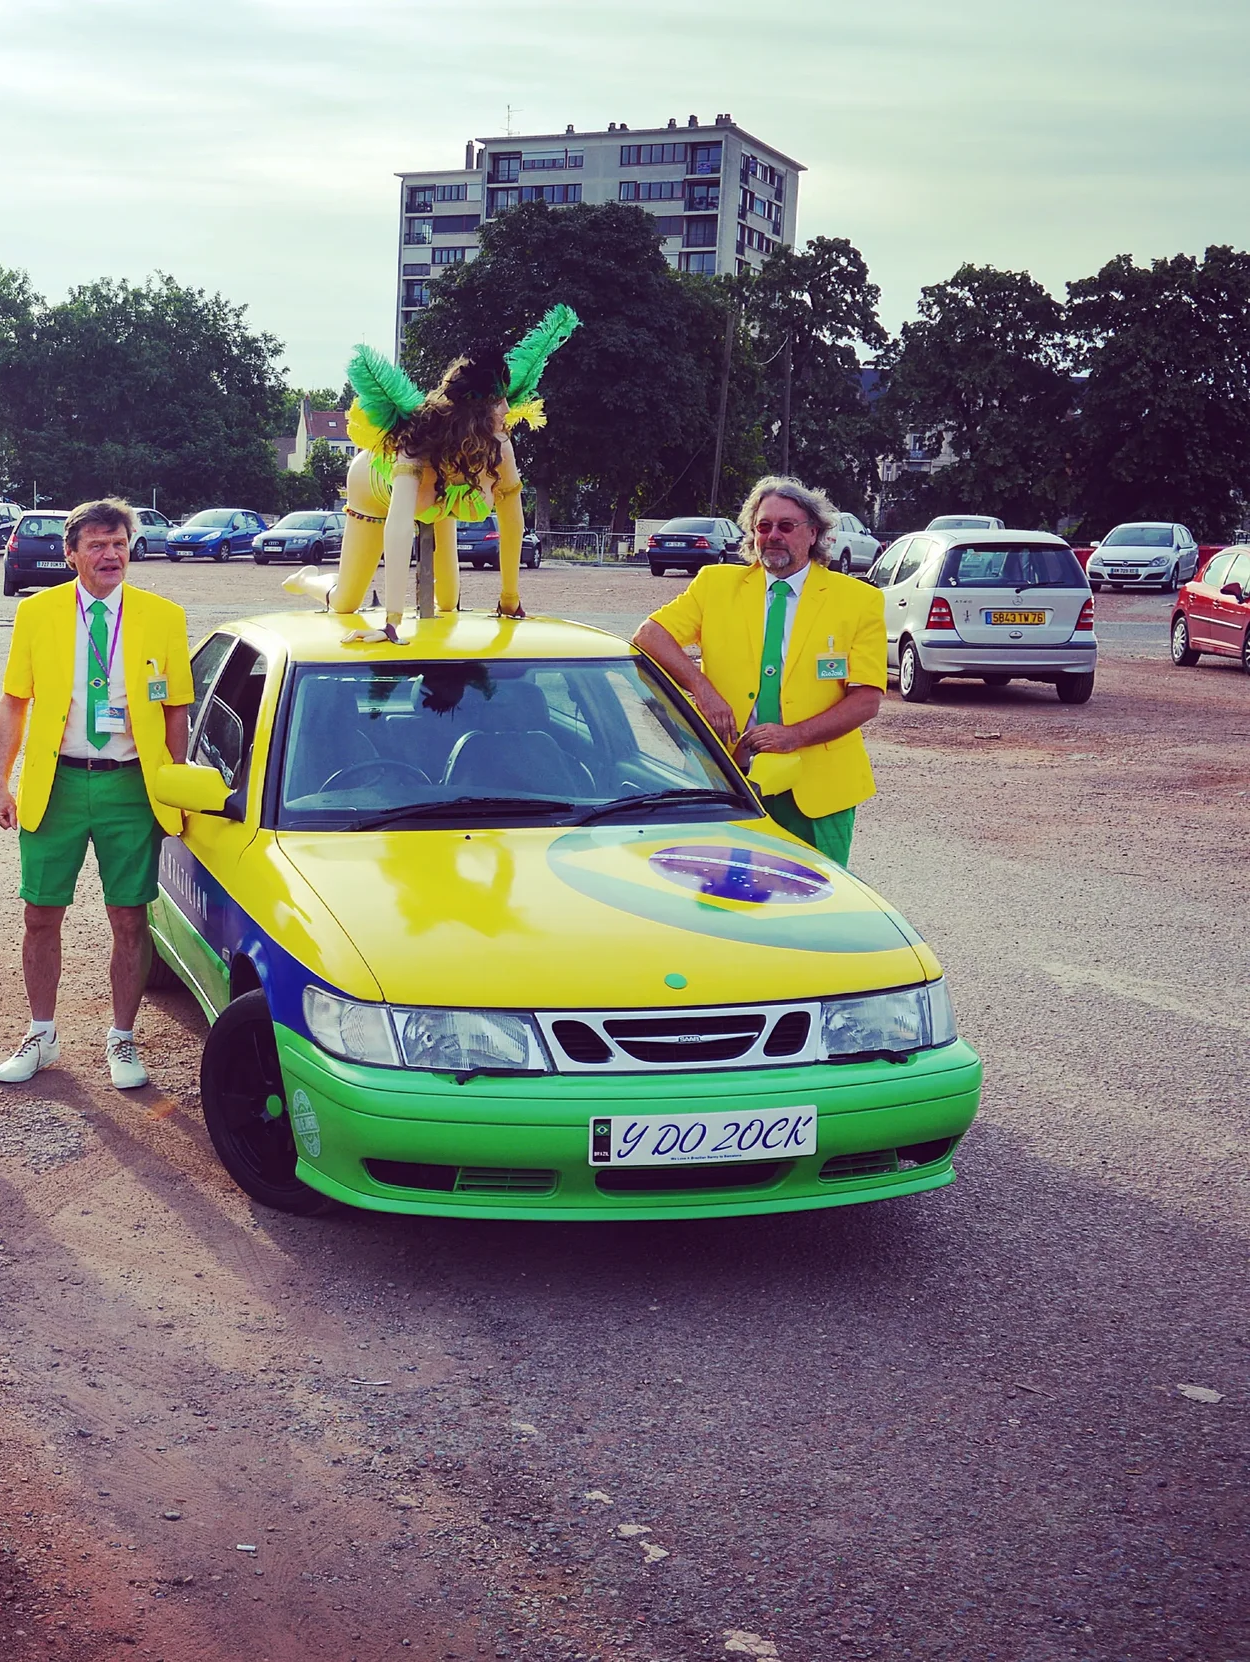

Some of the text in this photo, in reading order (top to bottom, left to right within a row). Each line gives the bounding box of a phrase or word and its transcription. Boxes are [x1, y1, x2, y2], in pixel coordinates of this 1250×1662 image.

[992, 613, 1043, 622] 5843 TW 76
[168, 852, 207, 921] BRAZILIAN
[617, 1122, 649, 1159] Y
